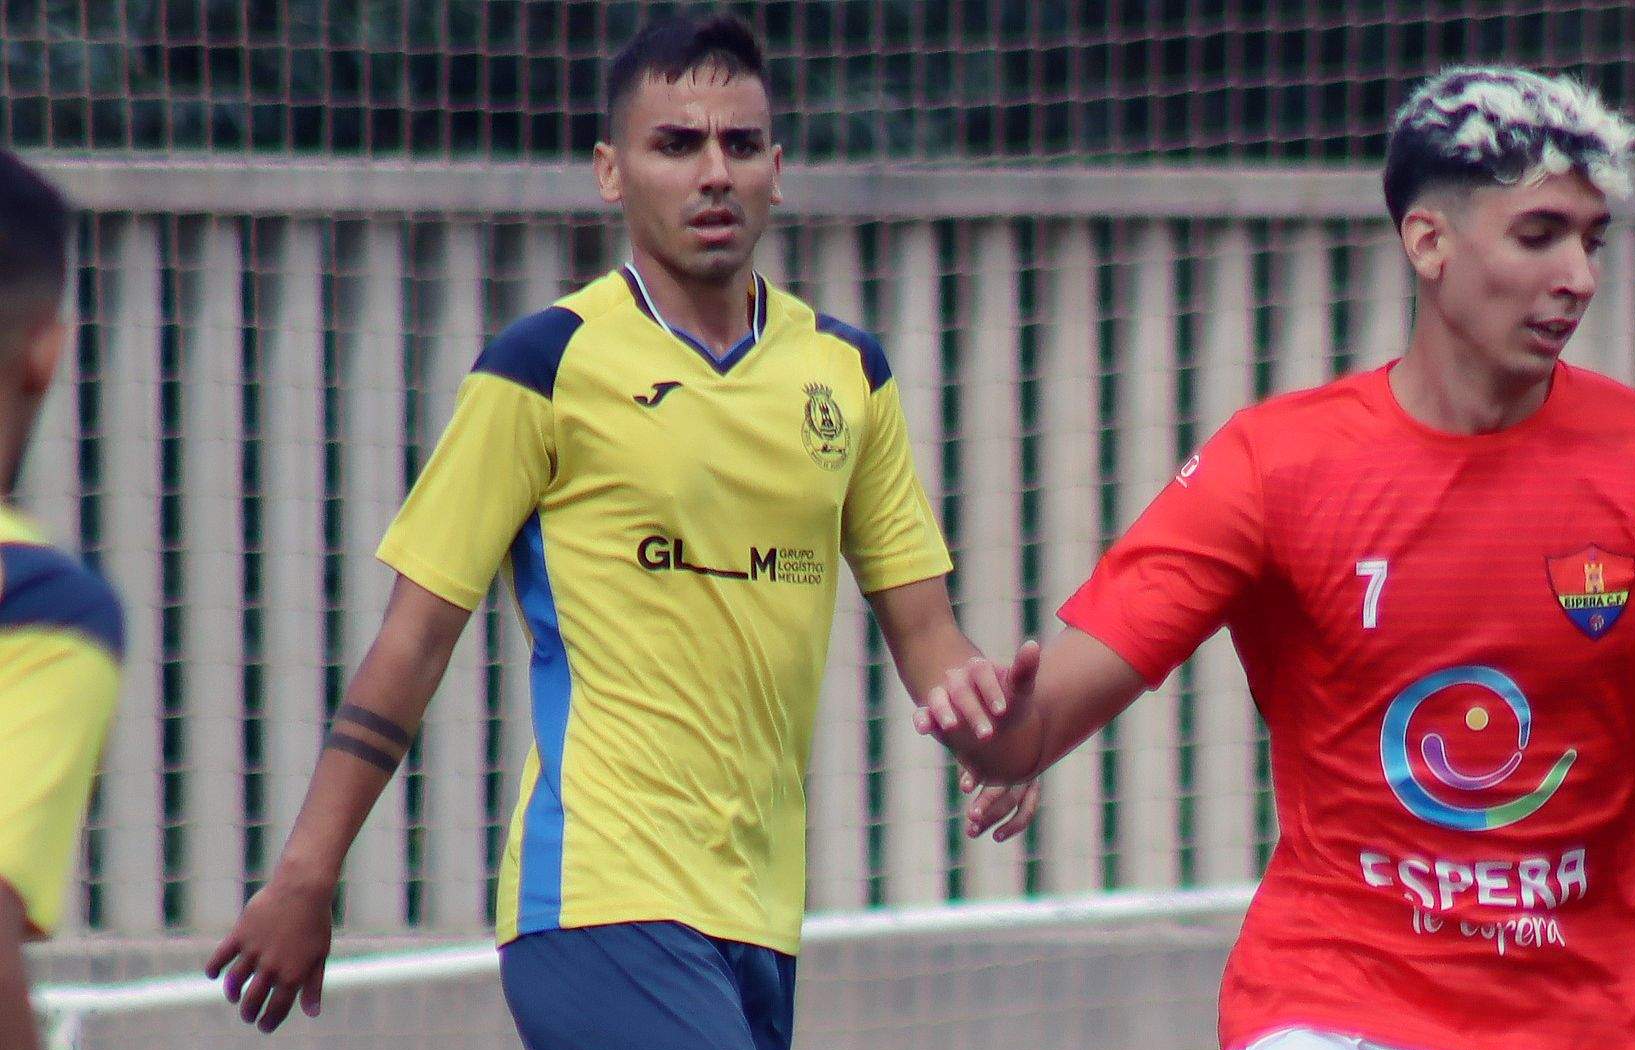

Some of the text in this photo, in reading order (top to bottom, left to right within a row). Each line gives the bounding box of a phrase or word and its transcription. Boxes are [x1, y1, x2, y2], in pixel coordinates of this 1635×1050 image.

[779, 549, 814, 560] GRUPO
[1356, 560, 1388, 629] 7
[1360, 848, 1588, 911] ESPERA
